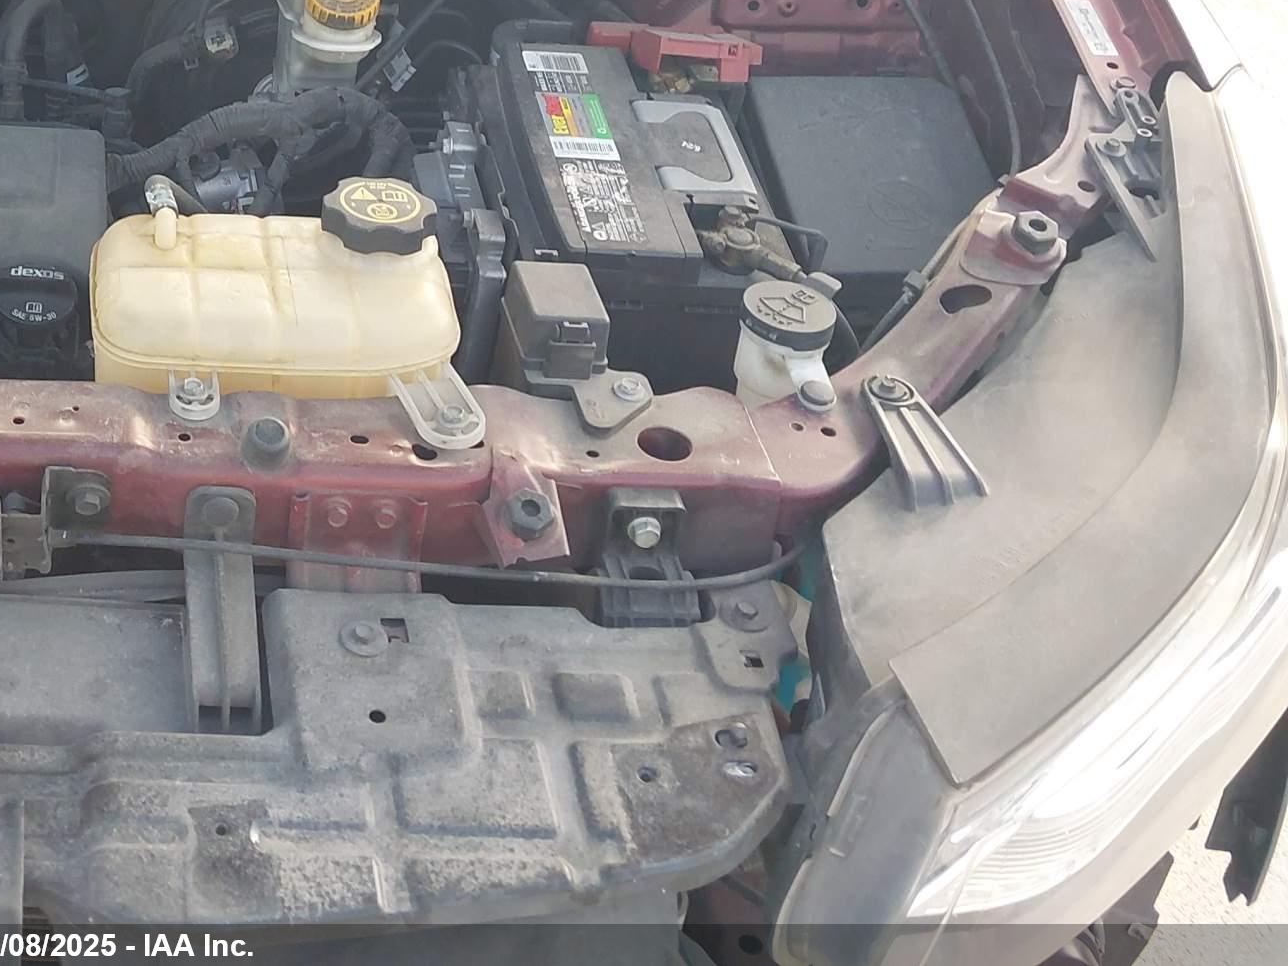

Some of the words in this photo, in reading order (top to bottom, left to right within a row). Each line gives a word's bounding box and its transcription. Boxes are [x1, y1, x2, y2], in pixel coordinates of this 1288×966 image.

[10, 265, 65, 280] dexos
[12, 309, 26, 320] SAE
[29, 311, 57, 322] 5W-30
